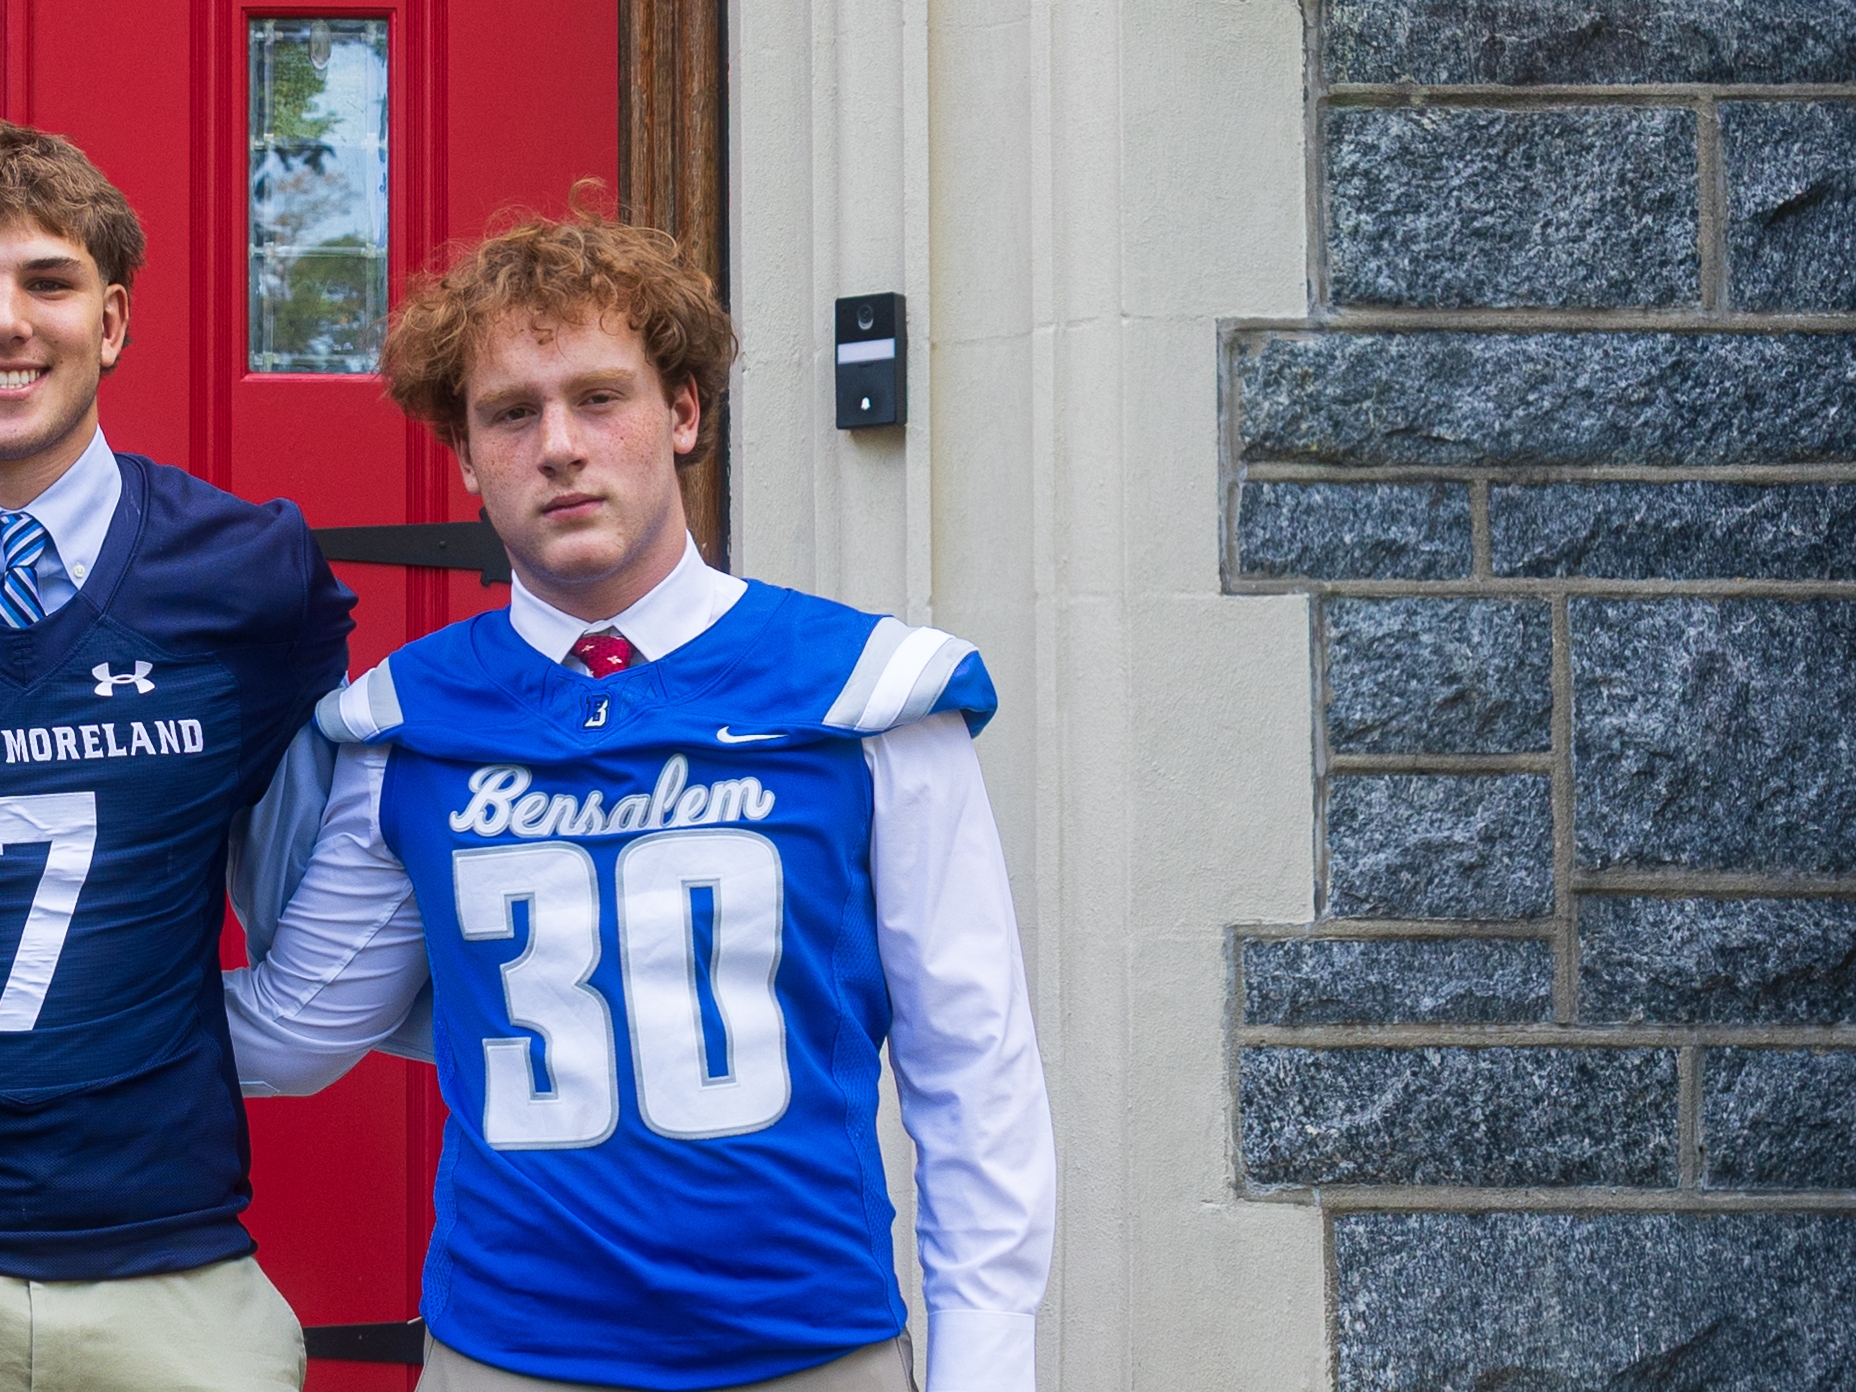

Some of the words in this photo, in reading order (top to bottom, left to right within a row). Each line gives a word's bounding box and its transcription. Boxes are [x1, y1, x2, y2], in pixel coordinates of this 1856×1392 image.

[0, 719, 204, 764] MORELAND
[449, 753, 776, 838] Bensalem
[451, 827, 792, 1151] 30
